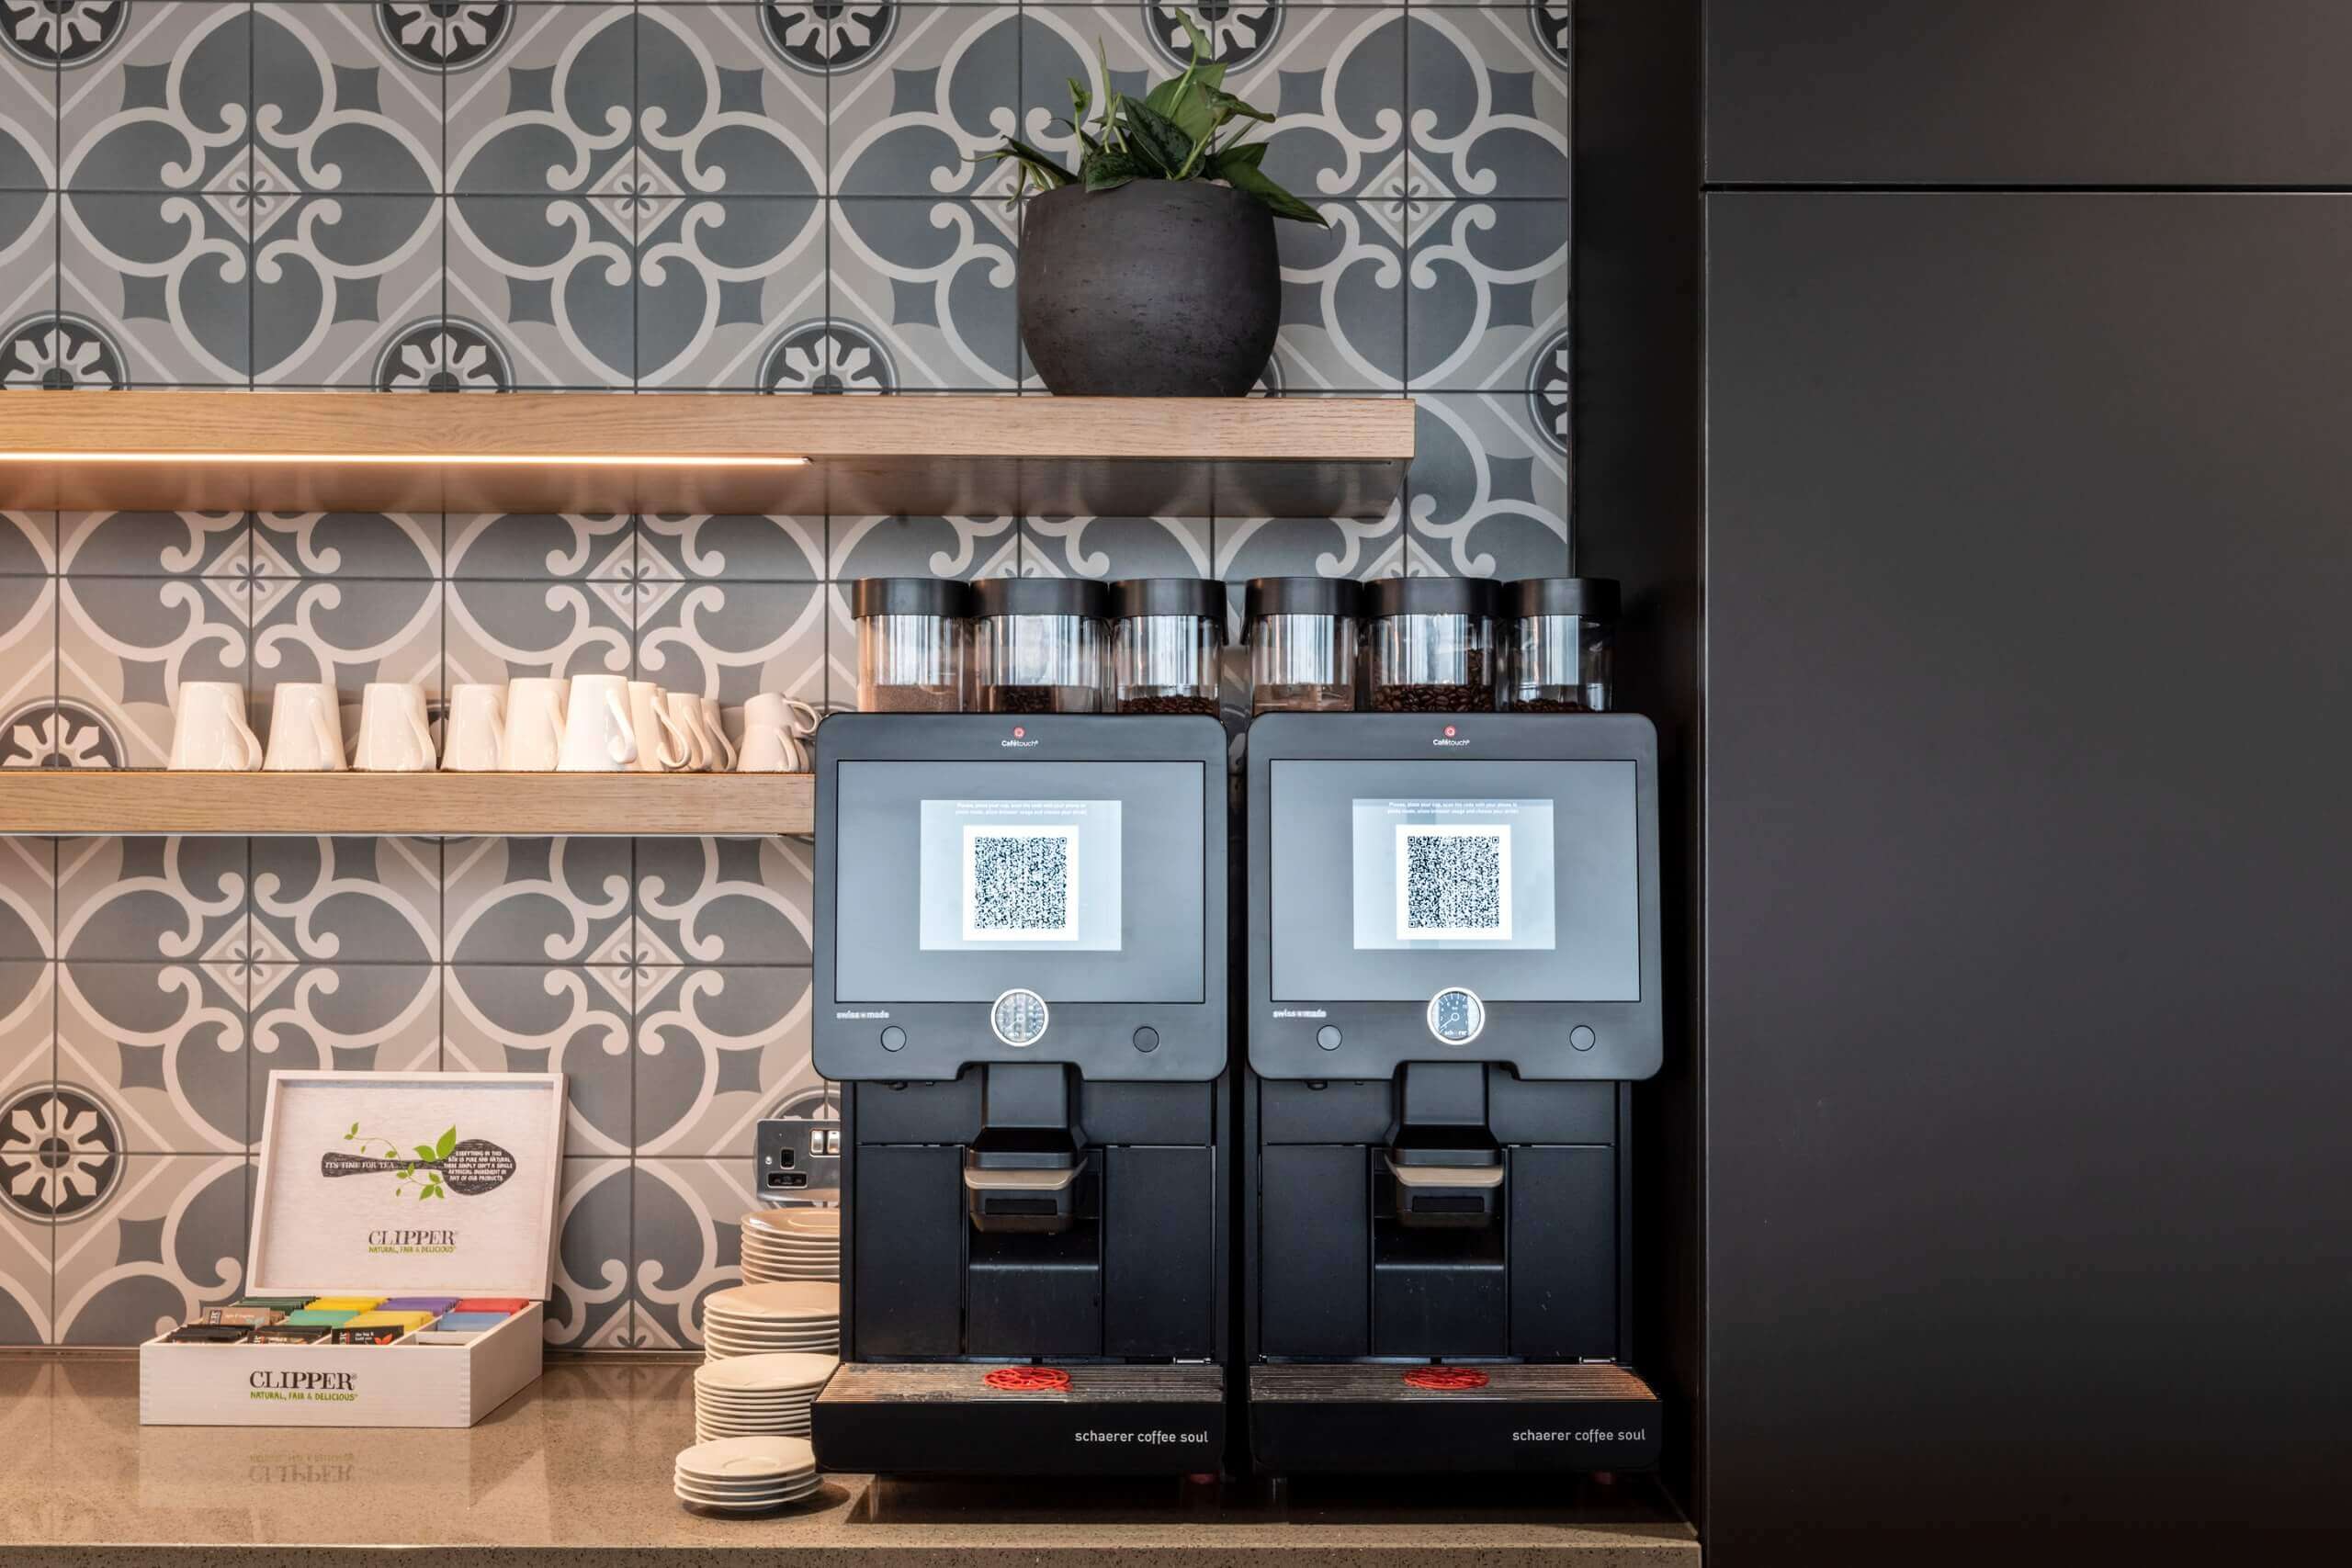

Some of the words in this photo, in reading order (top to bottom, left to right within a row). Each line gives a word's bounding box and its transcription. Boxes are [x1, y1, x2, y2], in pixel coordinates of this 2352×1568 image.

[250, 1392, 287, 1401] NATURAL,
[288, 1392, 305, 1400] FAIR
[1074, 1429, 1134, 1442] schaerer
[1137, 1429, 1176, 1445] coffee
[1180, 1430, 1208, 1443] soul
[1512, 1428, 1572, 1441] schaerer
[1575, 1428, 1614, 1443] coffee
[1617, 1428, 1645, 1441] soul
